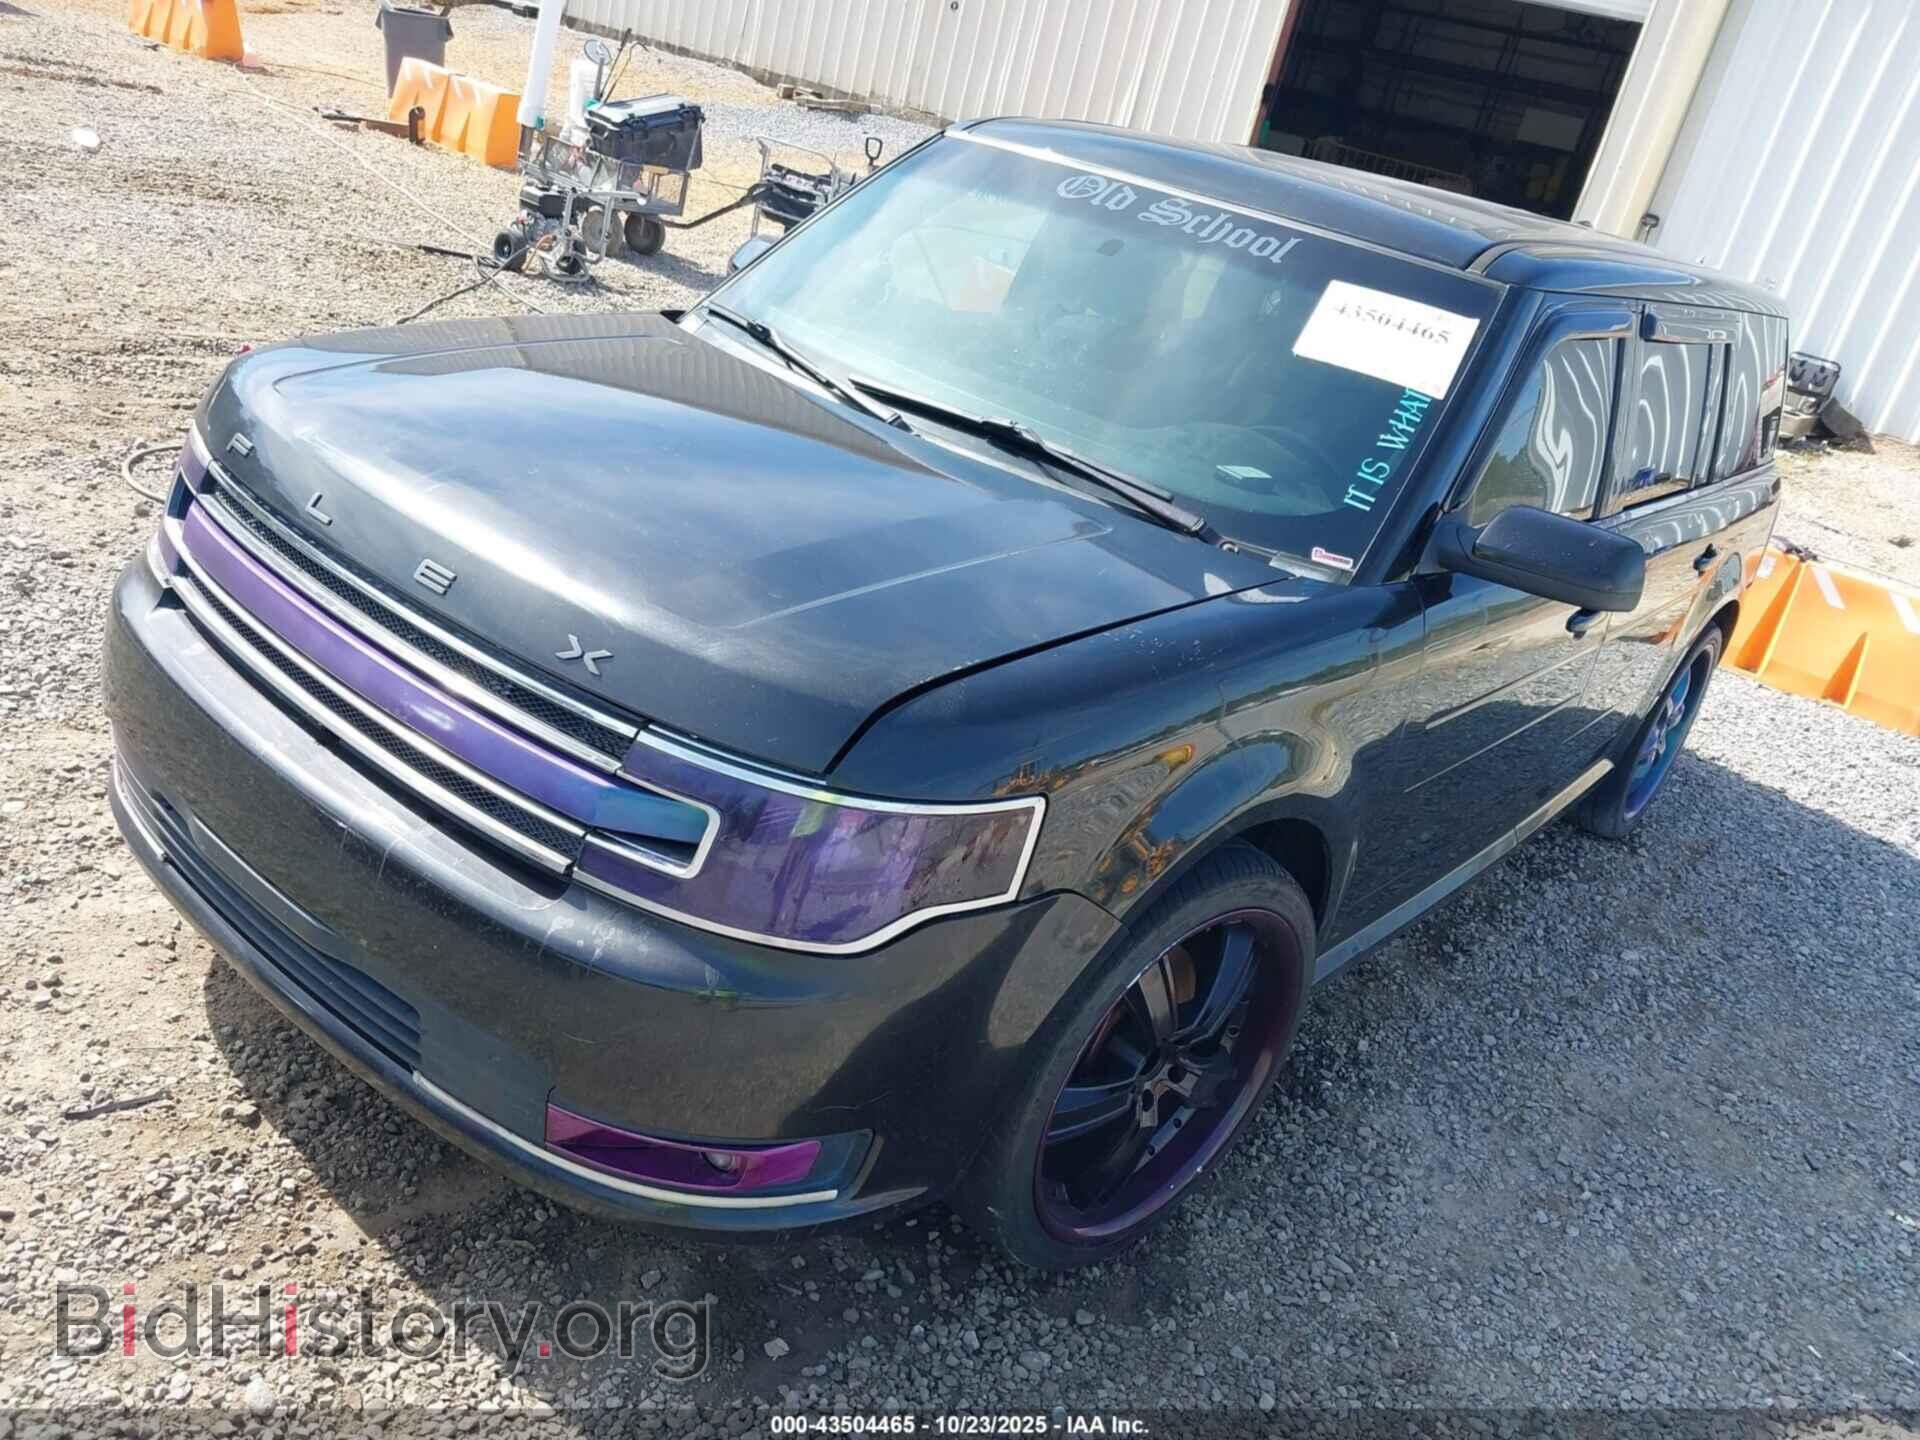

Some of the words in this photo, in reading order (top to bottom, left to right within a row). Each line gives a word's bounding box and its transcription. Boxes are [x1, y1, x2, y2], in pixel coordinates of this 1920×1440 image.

[1056, 175, 1138, 211] Old
[1137, 198, 1303, 263] School
[1334, 303, 1452, 345] 43504465
[1356, 457, 1391, 486] IS
[1343, 483, 1377, 512] IT
